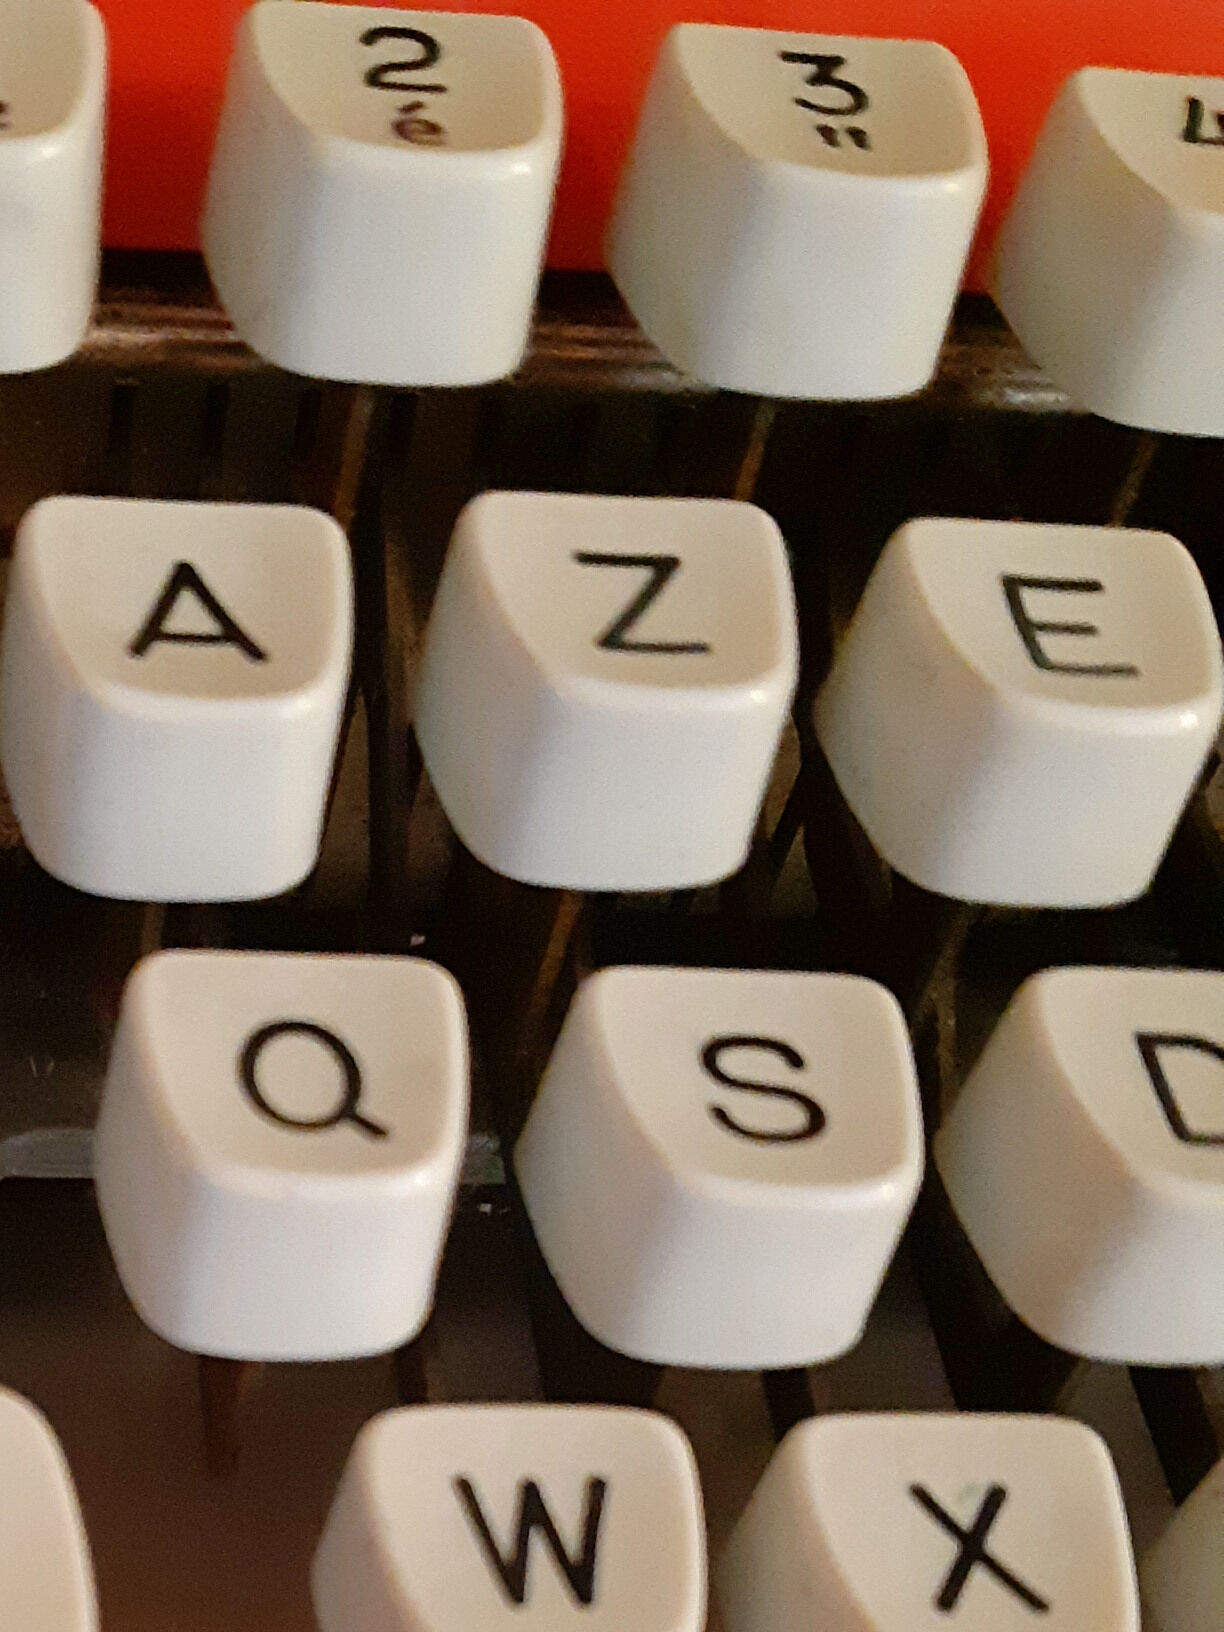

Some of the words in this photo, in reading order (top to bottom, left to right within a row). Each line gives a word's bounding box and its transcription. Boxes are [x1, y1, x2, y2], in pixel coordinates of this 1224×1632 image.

[359, 26, 448, 94] 2
[778, 51, 870, 117] 3
[127, 561, 270, 664] A
[573, 552, 712, 655] Z
[1001, 574, 1139, 678] E
[237, 1019, 389, 1141] Q
[699, 1034, 827, 1145] S
[455, 1476, 608, 1609] W
[909, 1484, 1050, 1615] X
